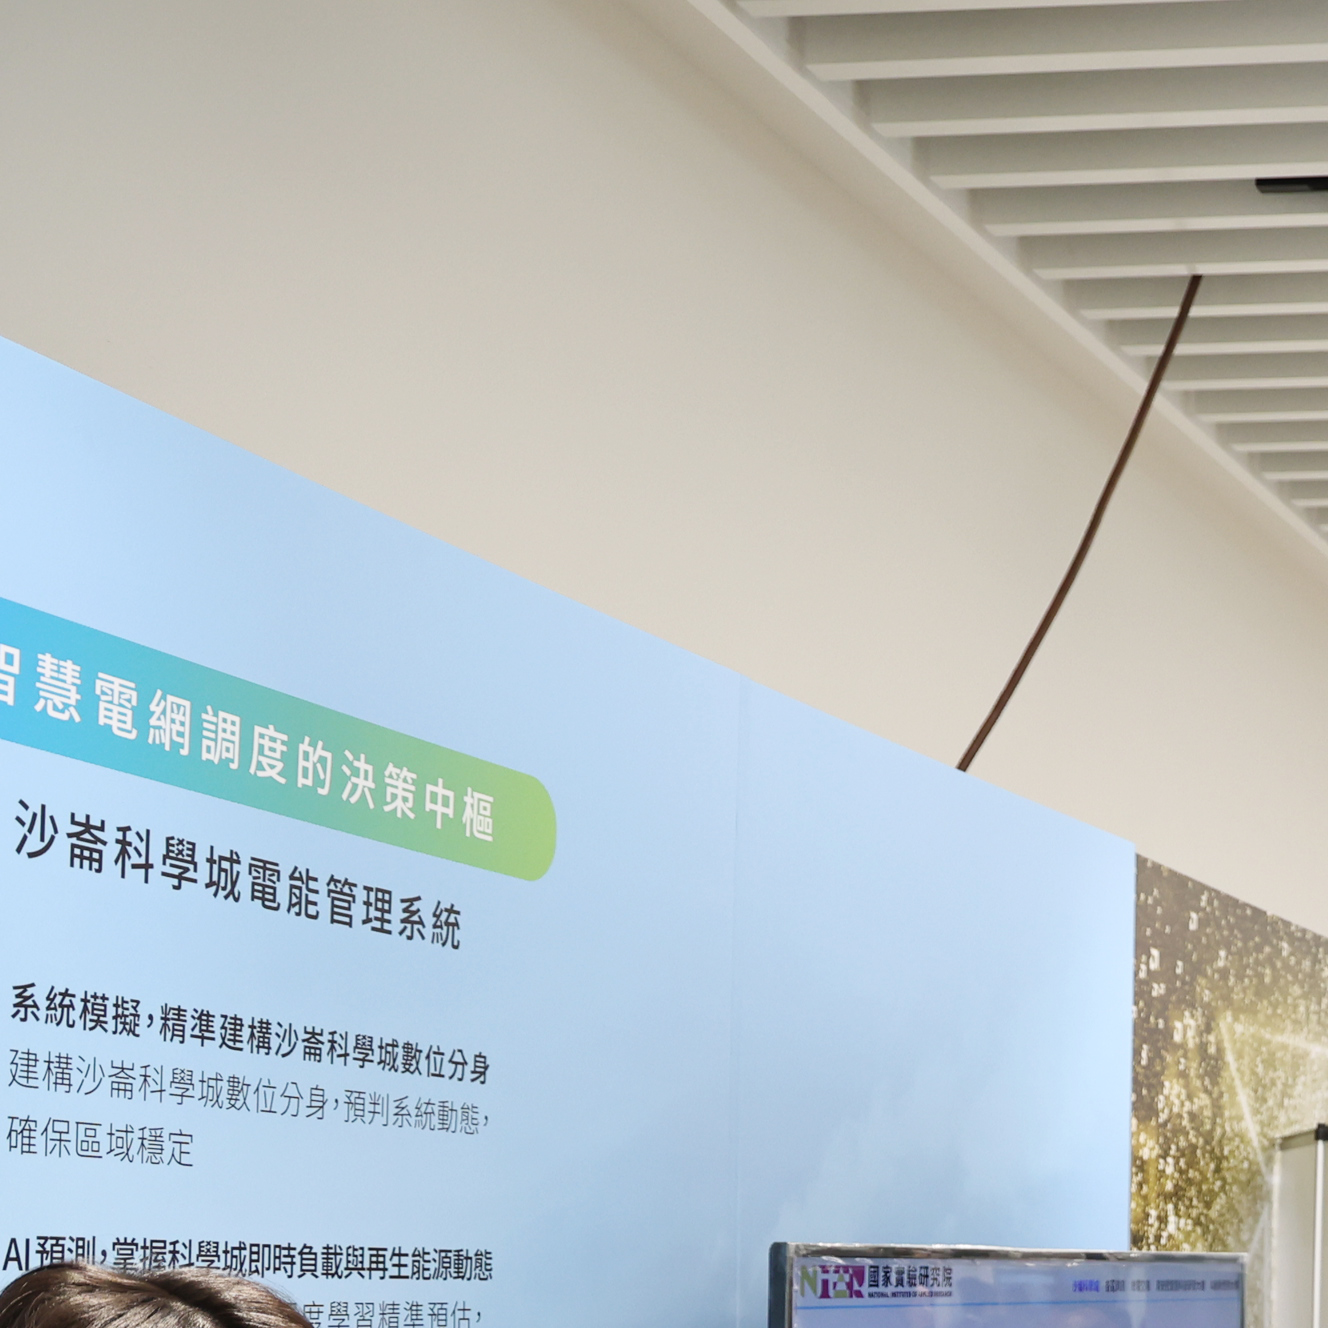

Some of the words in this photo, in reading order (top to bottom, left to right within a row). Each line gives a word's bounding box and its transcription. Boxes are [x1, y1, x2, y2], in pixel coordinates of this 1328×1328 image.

[14, 798, 461, 951] 沙崙科學城電能管理系統
[6, 1115, 194, 1167] 確保區域穩定
[867, 1265, 953, 1289] 國家實驗研究院
